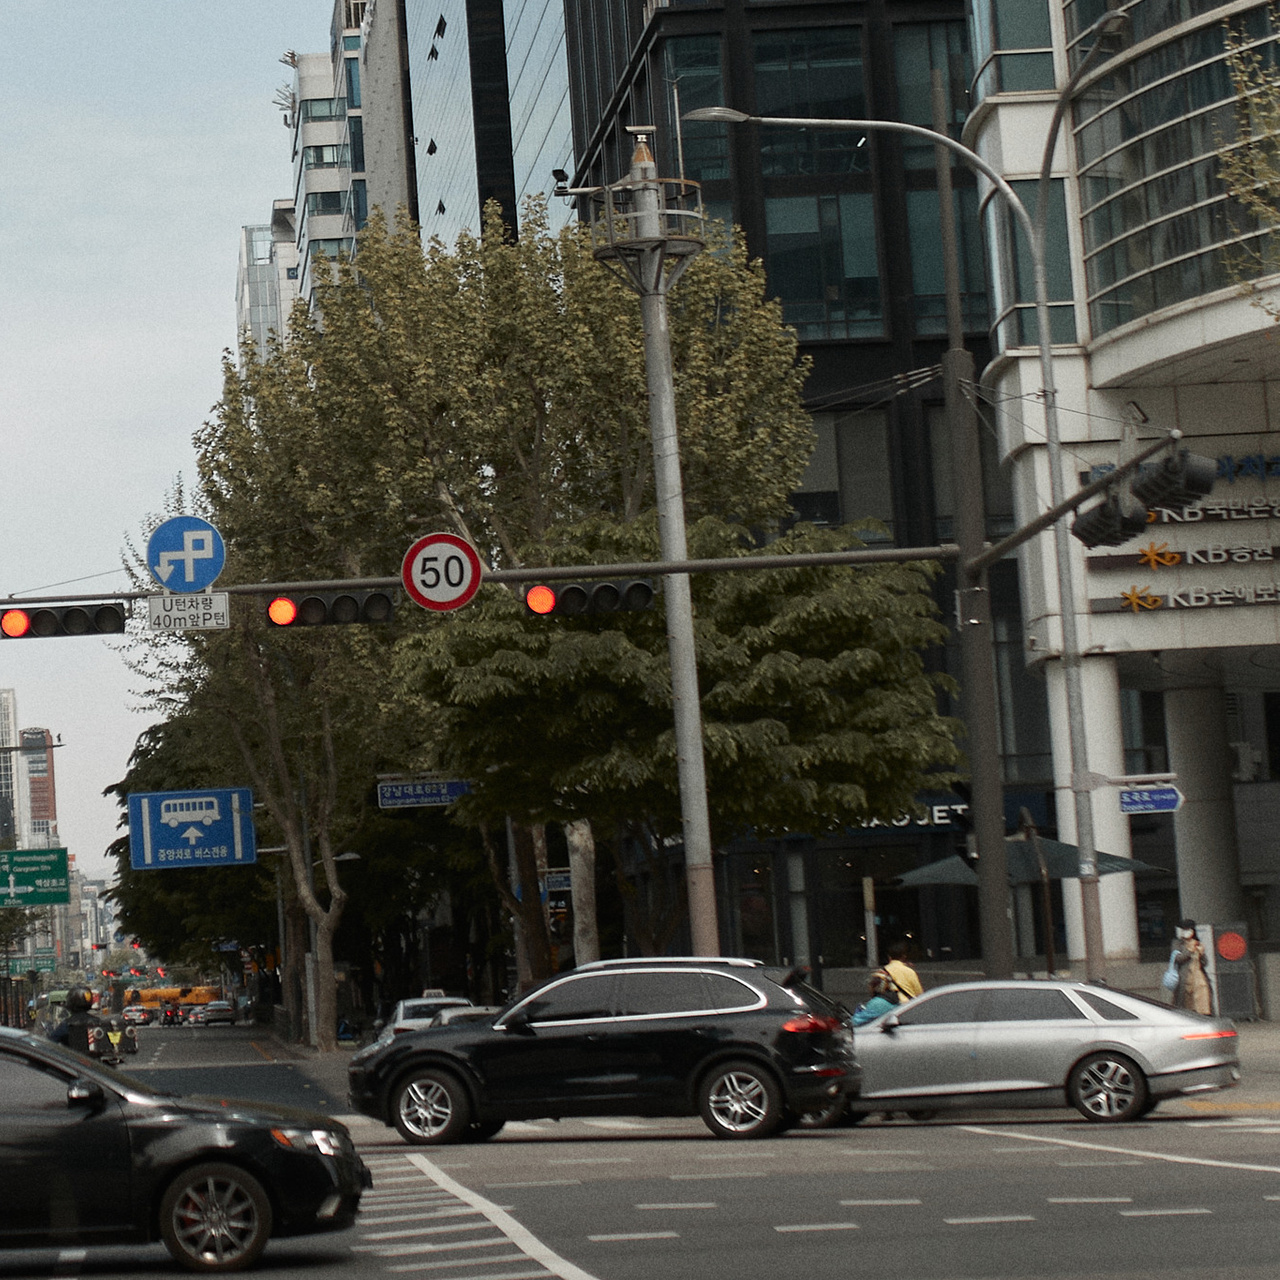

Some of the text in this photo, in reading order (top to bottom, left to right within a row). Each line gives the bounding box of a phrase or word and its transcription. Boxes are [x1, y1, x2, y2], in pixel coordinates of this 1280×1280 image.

[420, 555, 464, 589] 50
[162, 597, 213, 613] U턴차량
[1169, 583, 1280, 608] KB손해보
[157, 845, 228, 862] 중앙차로 버스전용
